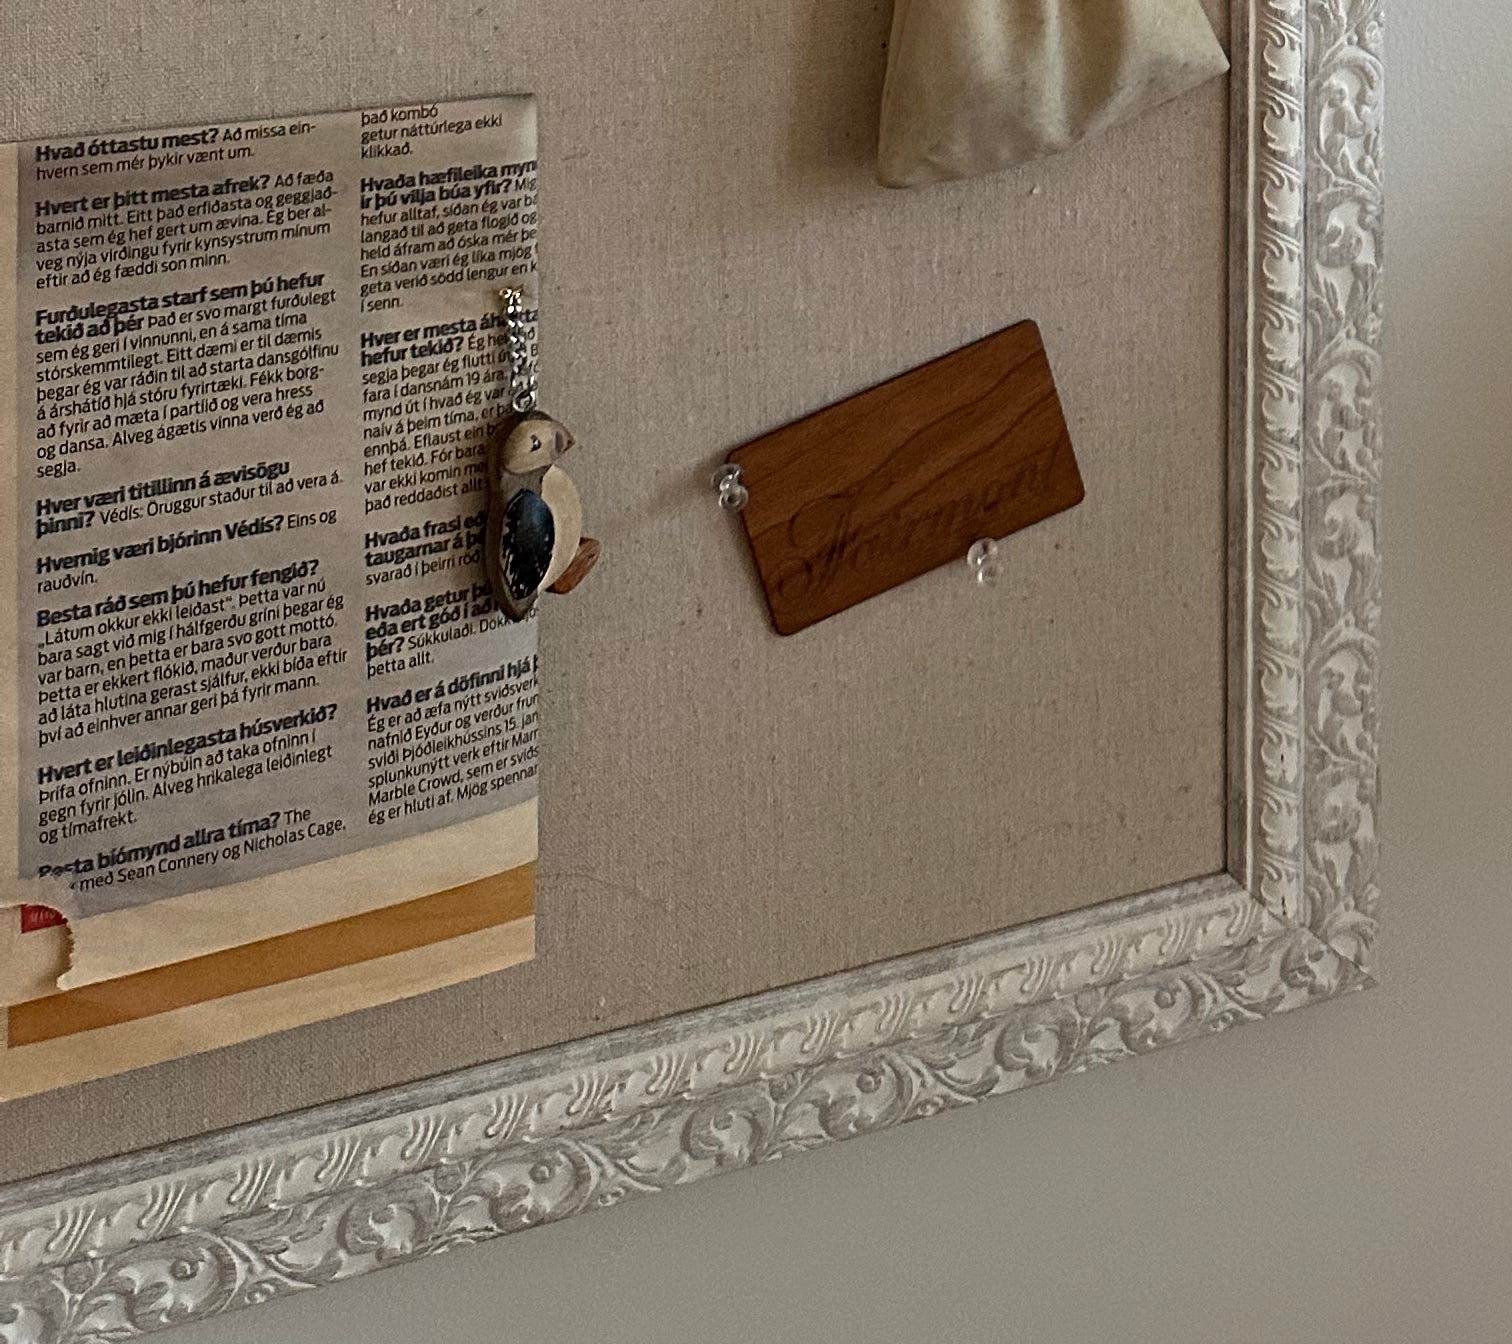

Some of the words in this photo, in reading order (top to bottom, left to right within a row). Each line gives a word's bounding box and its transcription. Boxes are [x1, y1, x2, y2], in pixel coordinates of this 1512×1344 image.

[35, 141, 84, 162] Hvað
[87, 135, 158, 156] óttastu
[161, 127, 218, 148] mest?
[222, 127, 241, 141] Að
[244, 125, 285, 140] missa
[288, 121, 315, 135] ein-
[34, 196, 88, 217] Hvert
[91, 196, 110, 210] er
[113, 190, 147, 210] þitt
[151, 183, 209, 203] mesta
[211, 174, 270, 195] afrek?
[274, 173, 293, 188] Að
[296, 169, 333, 185] fæða
[360, 173, 415, 193] Hvaða
[360, 194, 372, 209] ir
[374, 190, 397, 210] þú
[438, 182, 471, 200] búa
[161, 285, 207, 307] starf
[209, 284, 247, 301] sem
[250, 279, 274, 298] þú
[276, 271, 324, 292] hefur
[34, 322, 84, 344] tekið
[86, 317, 111, 337] að
[112, 313, 144, 336] þér
[147, 311, 175, 328] Það
[178, 311, 193, 324] er
[196, 307, 220, 321] svo
[223, 299, 267, 317] margt
[360, 346, 408, 367] hefur
[410, 335, 463, 358] tekið?
[35, 510, 95, 539] þinni?
[146, 495, 206, 516] Öruggur
[208, 486, 255, 505] staður
[258, 481, 272, 496] til
[275, 477, 293, 494] að
[296, 475, 327, 490] vera
[36, 496, 81, 516] Hver
[83, 485, 125, 508] væri
[127, 477, 196, 500] titillinn
[198, 470, 211, 488] á
[36, 547, 110, 574] Hvernig
[112, 537, 154, 560] væri
[157, 528, 221, 553] bjórinn
[224, 514, 284, 539] Védís?
[287, 513, 316, 529] Eins
[319, 509, 336, 524] og
[36, 604, 92, 627] Besta
[95, 594, 126, 616] ráð
[128, 590, 168, 609] sem
[171, 584, 195, 604] þú
[198, 574, 248, 596] hefur
[250, 558, 319, 586] fengið?
[365, 636, 404, 662] þér?
[366, 689, 412, 713] Hvað
[414, 687, 432, 701] er
[433, 679, 444, 696] á
[507, 655, 530, 679] hjá
[38, 758, 92, 784] Hvert
[94, 755, 114, 771] er
[368, 783, 415, 806] Marble
[418, 769, 460, 793] Crowd,
[79, 870, 113, 891] með
[116, 864, 155, 882] Sean
[158, 850, 218, 873] Connery
[221, 844, 240, 860] og
[243, 829, 304, 853] Nicholas
[307, 819, 345, 837] Cage.
[97, 834, 180, 869] bíómynd
[182, 828, 225, 849] allra
[227, 811, 280, 838] tíma?
[283, 808, 310, 824] The
